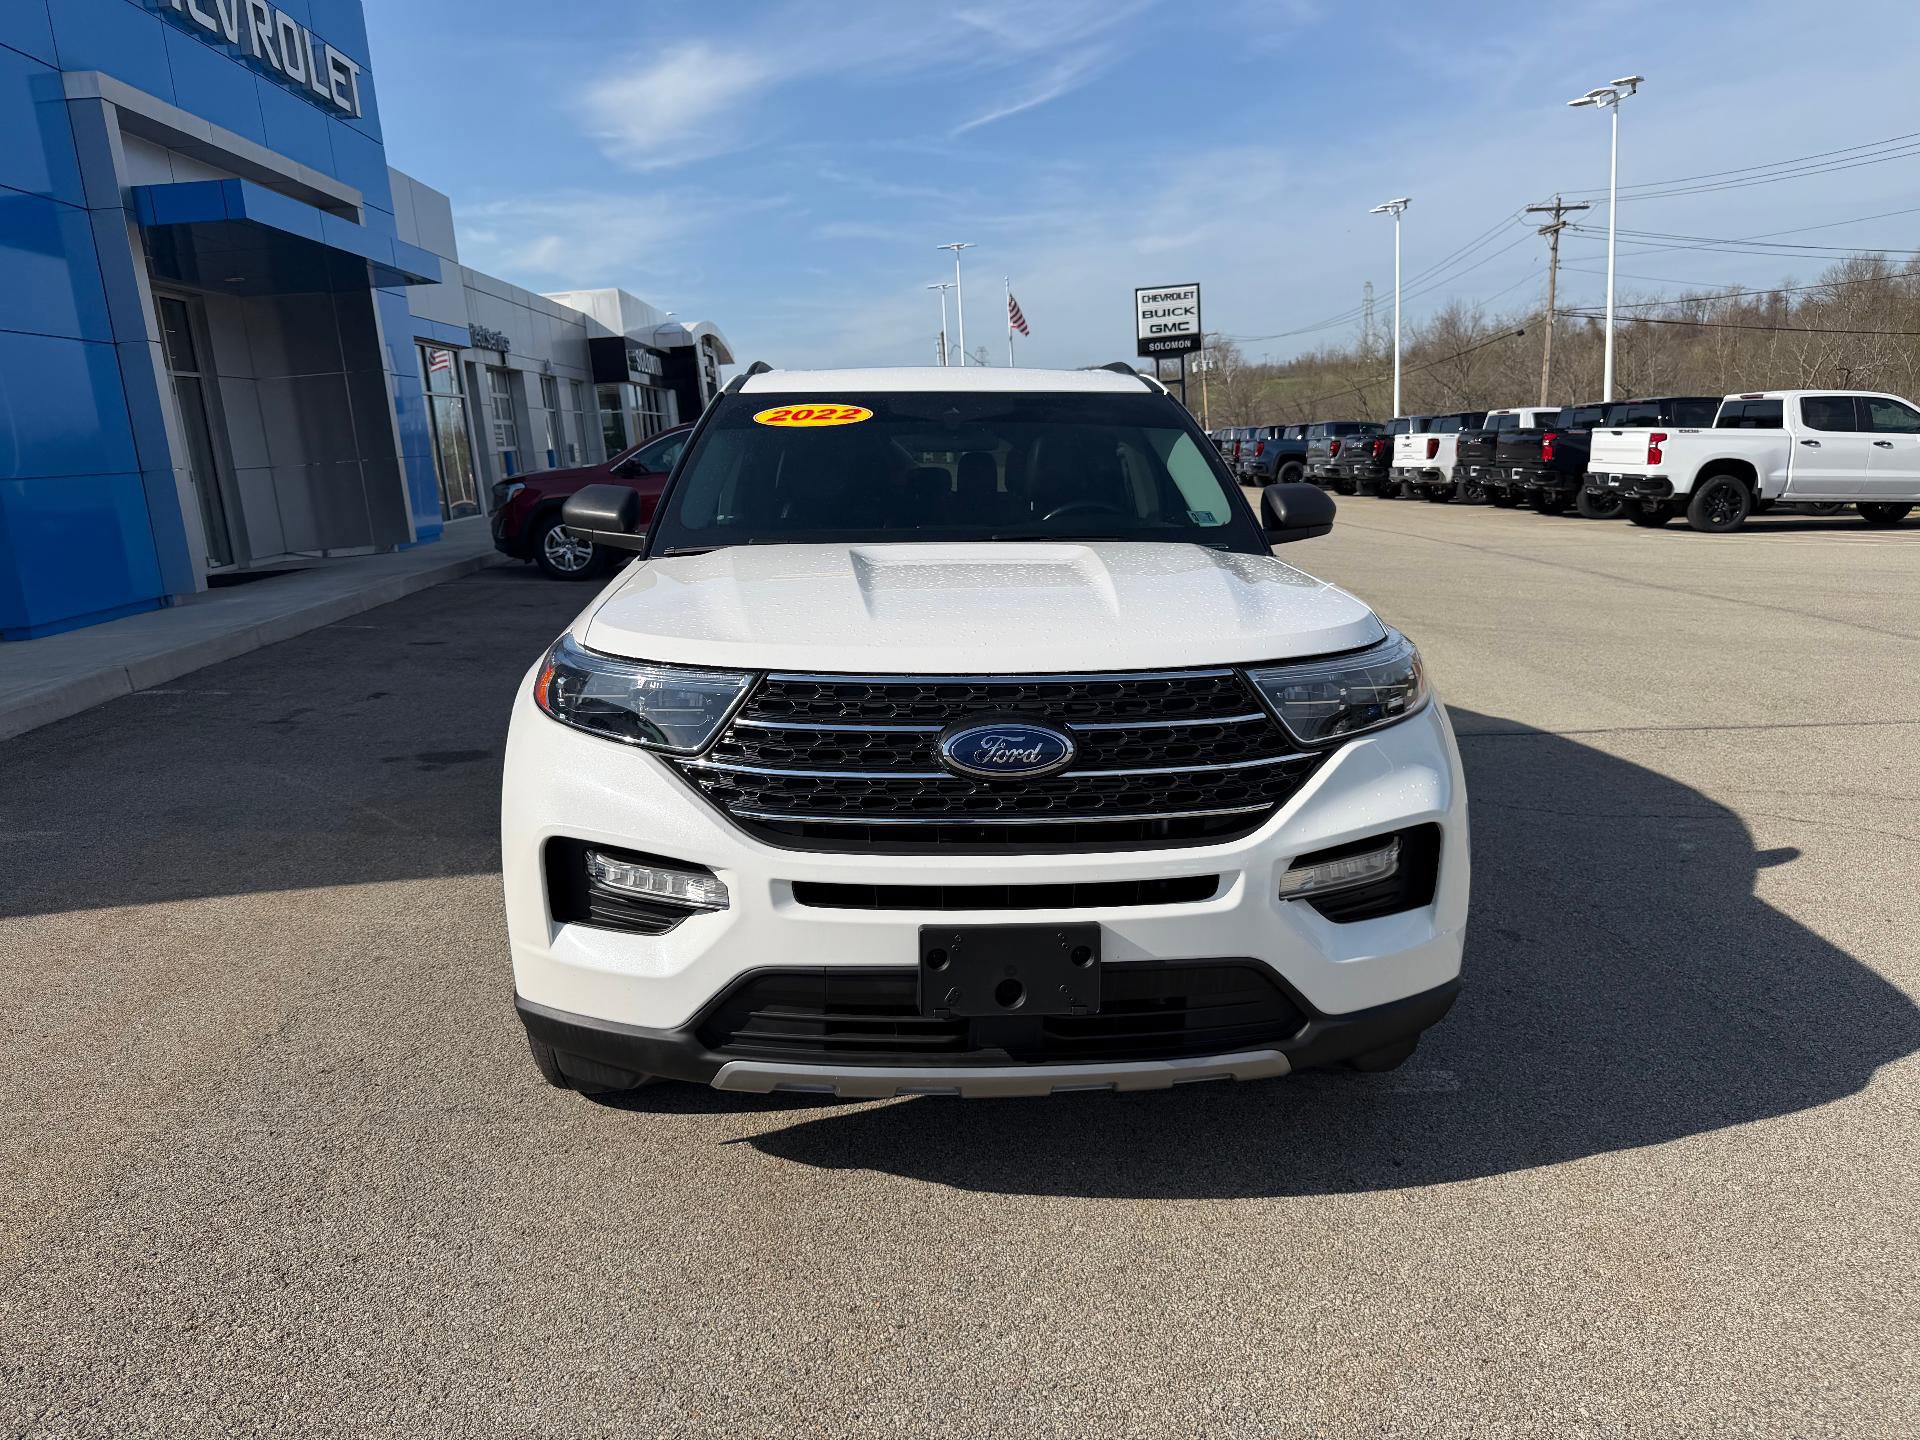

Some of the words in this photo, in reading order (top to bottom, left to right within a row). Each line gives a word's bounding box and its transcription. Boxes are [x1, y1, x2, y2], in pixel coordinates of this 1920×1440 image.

[1141, 291, 1195, 304] CHEVROLET
[1142, 306, 1196, 319] BUICK
[1150, 321, 1190, 334] GMC
[1148, 340, 1192, 351] SOLOMON
[764, 408, 863, 423] 2022
[973, 735, 1043, 764] Ford
